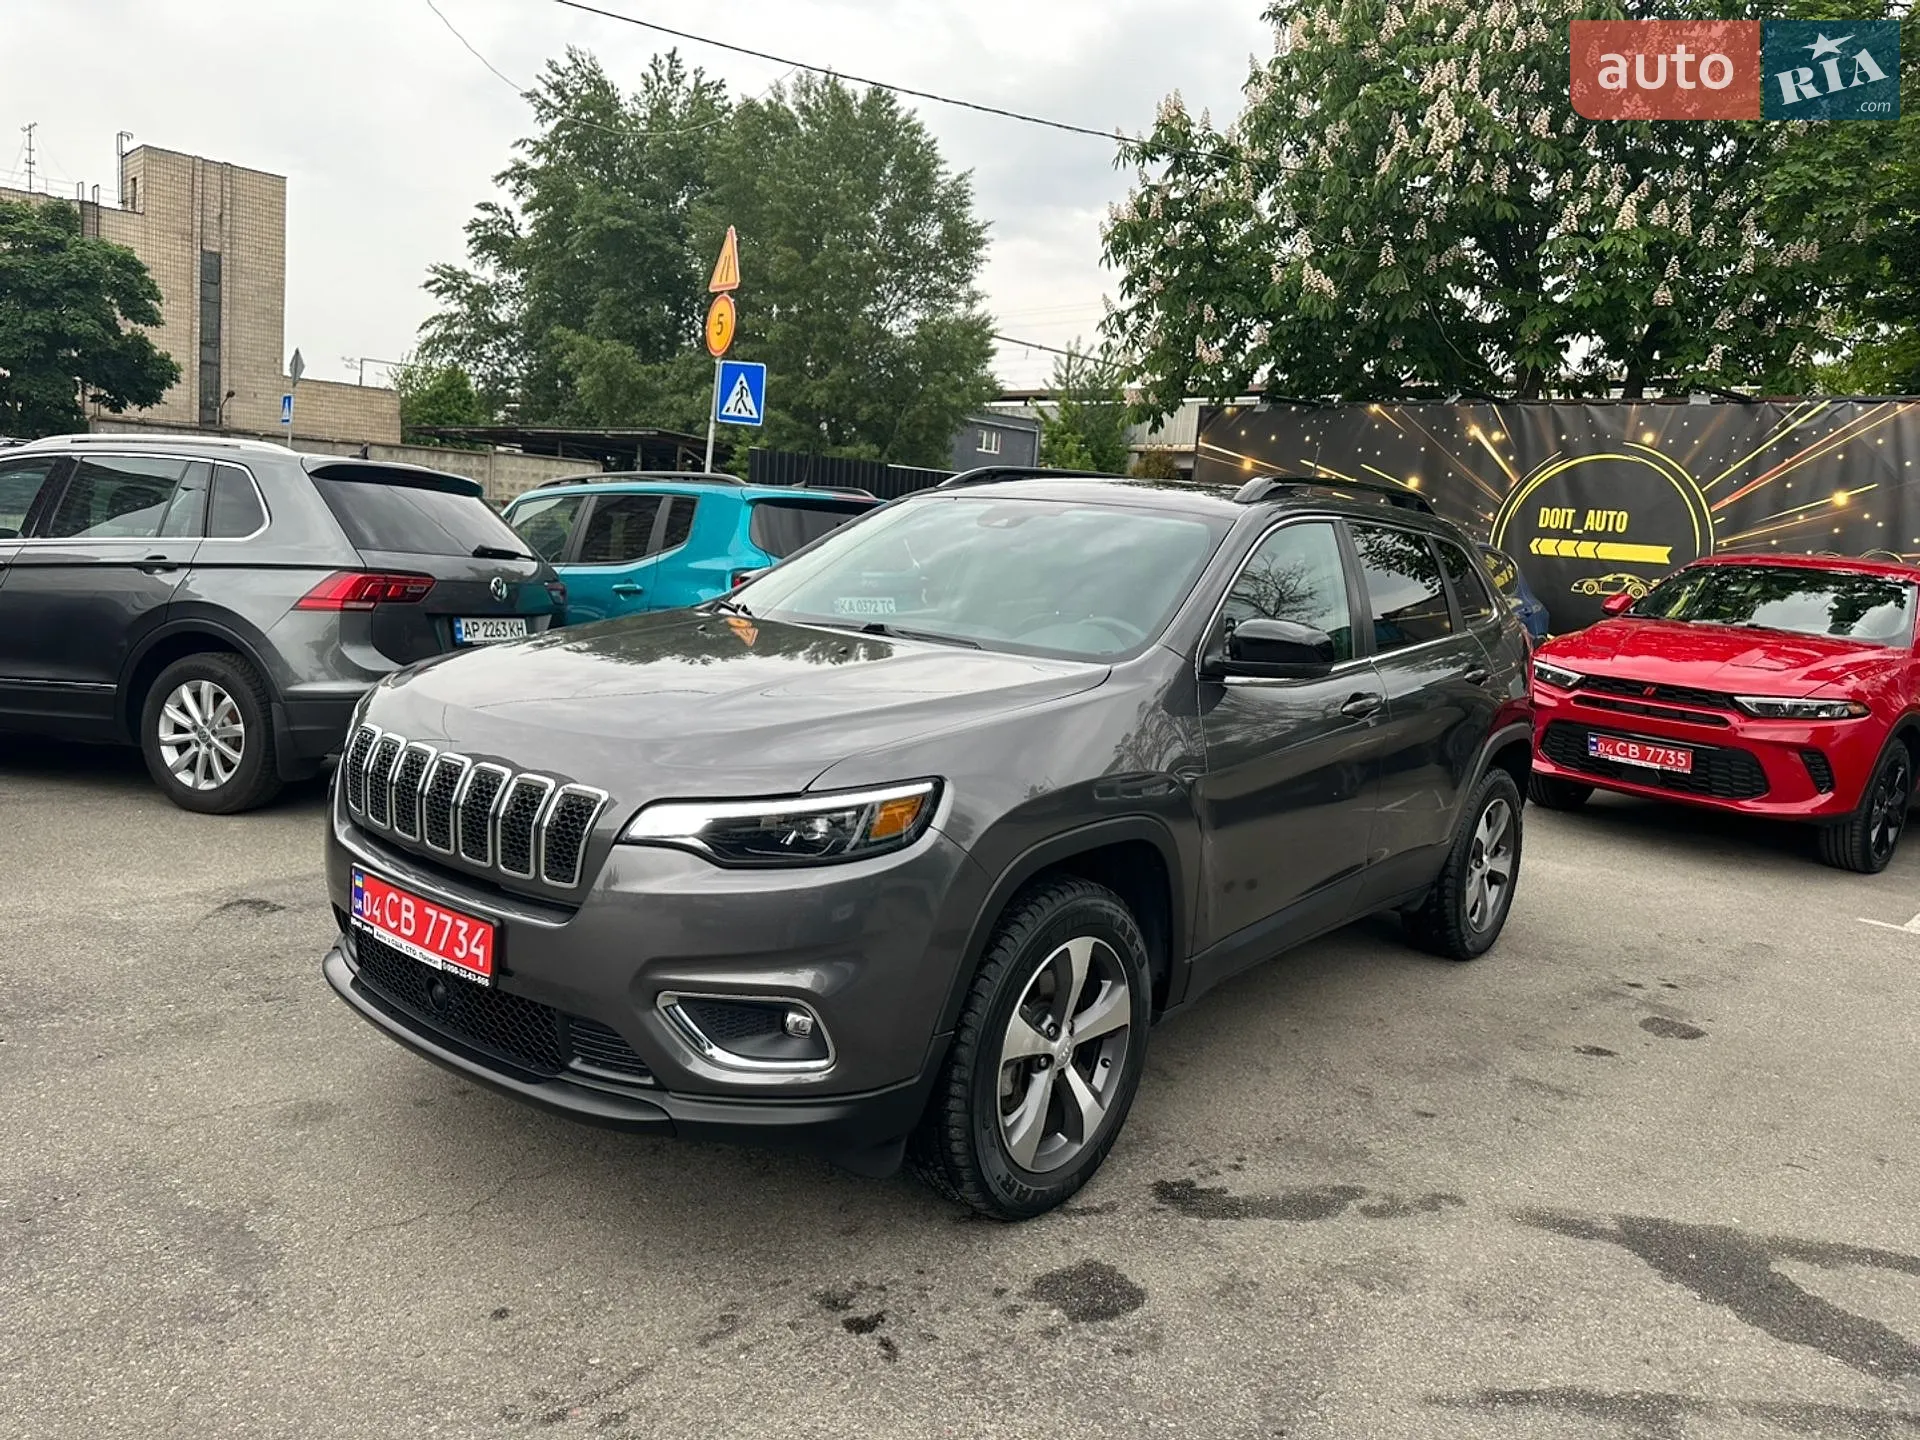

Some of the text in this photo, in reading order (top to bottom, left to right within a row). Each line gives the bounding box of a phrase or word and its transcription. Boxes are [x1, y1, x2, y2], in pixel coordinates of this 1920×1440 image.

[716, 313, 724, 336] 5
[1538, 507, 1628, 534] DOIT_AUTO
[464, 621, 480, 638] AP
[482, 621, 508, 638] 2263
[509, 620, 524, 637] KH
[1645, 746, 1687, 767] 7735
[424, 907, 486, 967] 7734
